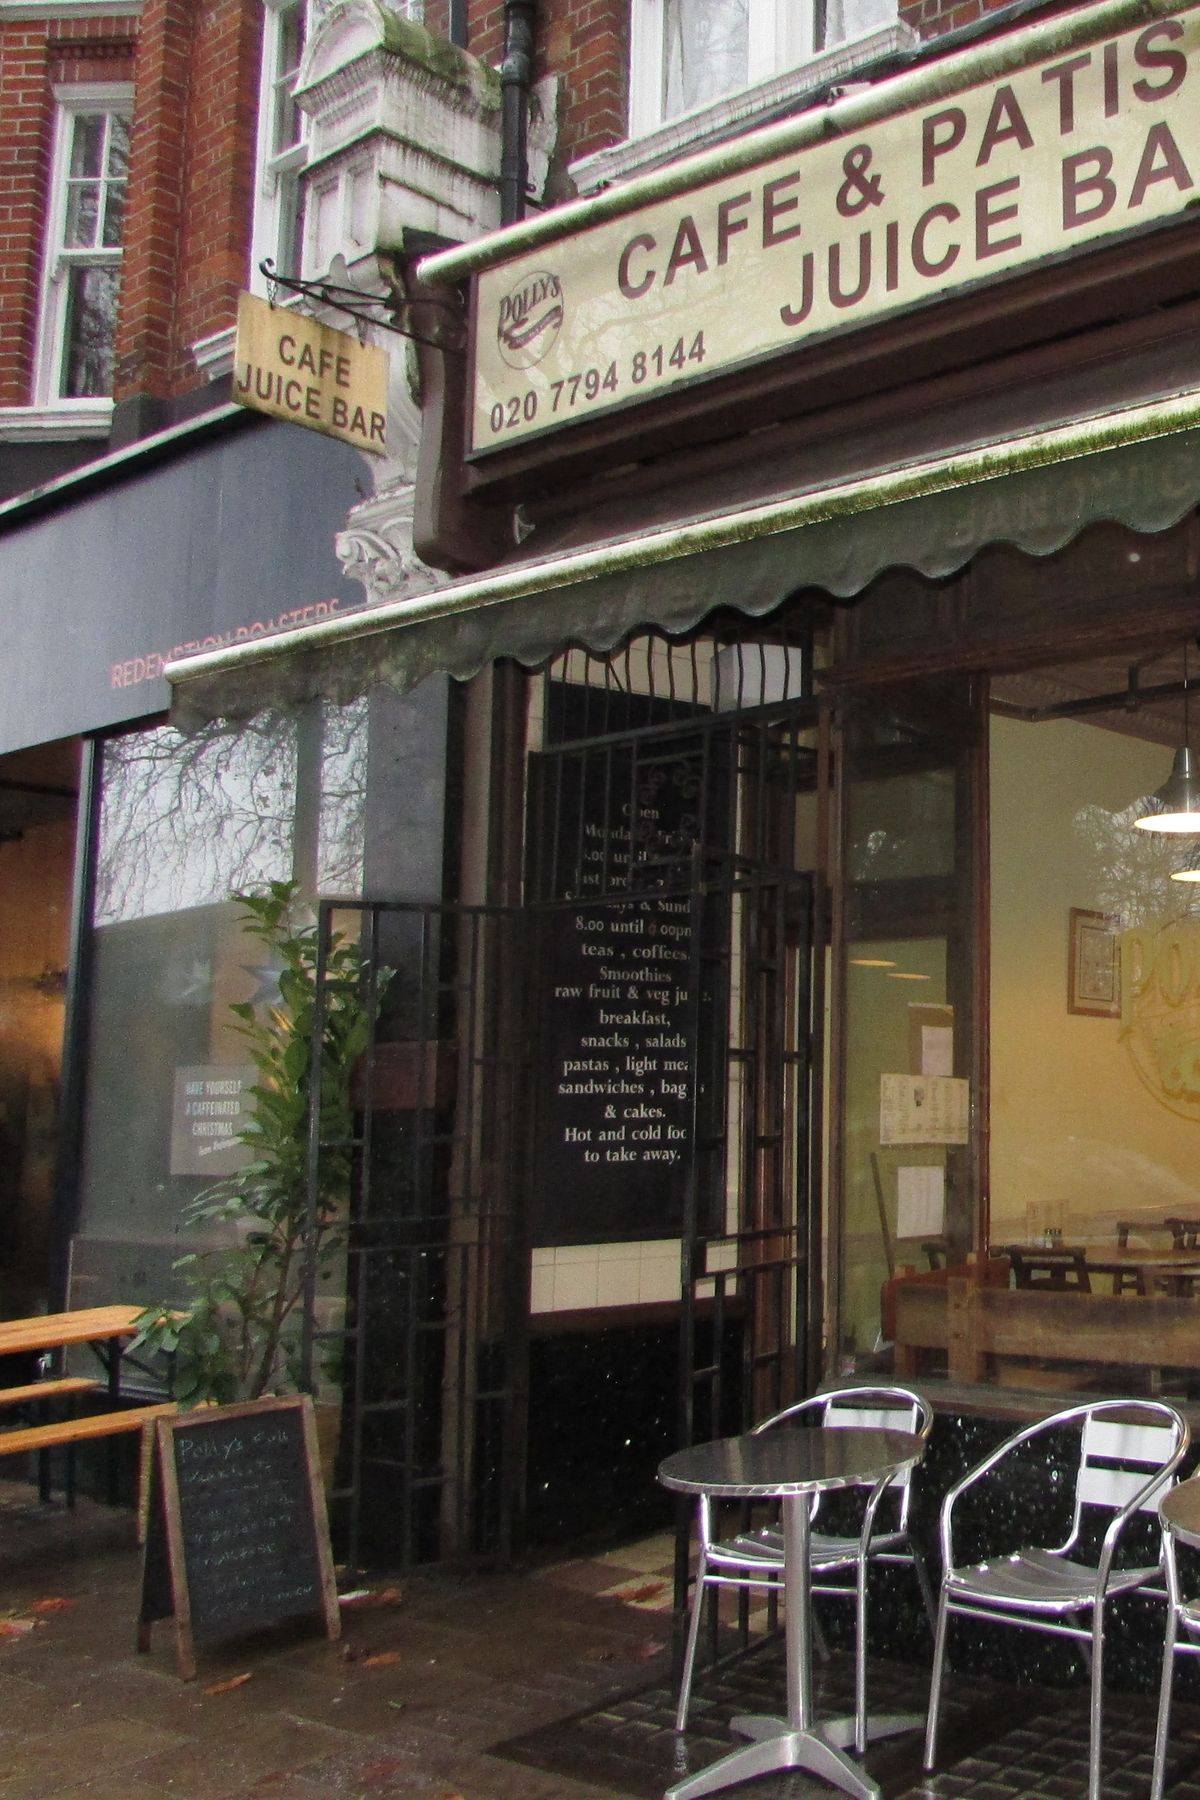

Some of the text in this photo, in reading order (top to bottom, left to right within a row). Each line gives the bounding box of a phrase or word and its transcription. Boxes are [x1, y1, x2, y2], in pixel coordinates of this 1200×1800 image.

[618, 174, 800, 299] CAFE
[836, 143, 885, 218] &
[781, 176, 1022, 327] JUICE
[278, 334, 351, 388] CAFE
[491, 331, 706, 433] 020 7794 8144
[237, 364, 386, 444] JUICE BAR
[610, 919, 644, 935] until
[600, 966, 672, 982] Smoothies
[555, 985, 582, 998] raw
[589, 984, 621, 999] fruit
[627, 985, 639, 1000] &
[647, 989, 669, 1006] veg
[600, 1009, 671, 1027] breakfast,
[645, 1033, 687, 1048] salads
[625, 1056, 658, 1076] light
[604, 1103, 666, 1119] & cakes.
[564, 1127, 592, 1142] Hot
[598, 1126, 626, 1141] and
[631, 1125, 662, 1140] cold
[584, 1147, 681, 1165] to take away.
